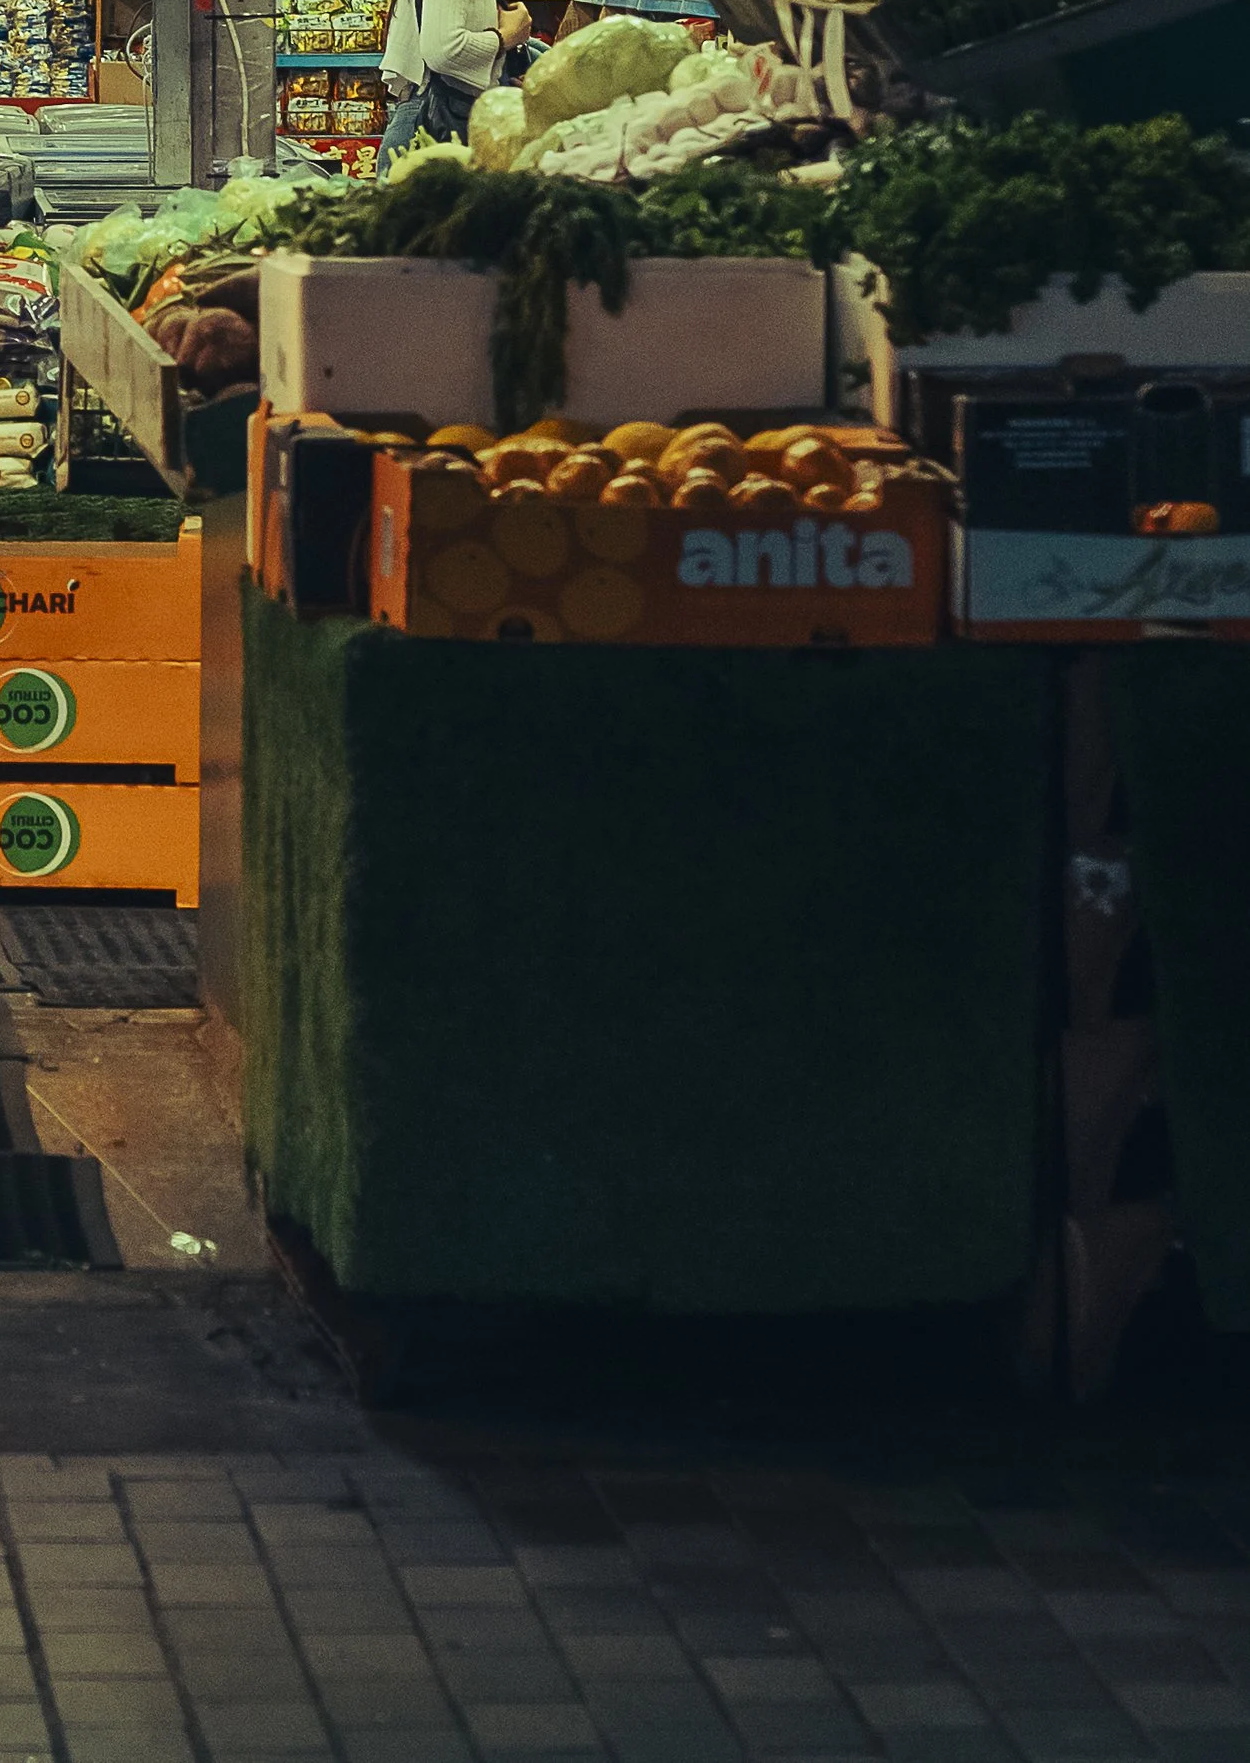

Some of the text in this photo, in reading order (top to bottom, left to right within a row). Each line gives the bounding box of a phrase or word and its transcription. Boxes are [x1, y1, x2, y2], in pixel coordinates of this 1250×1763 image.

[678, 518, 912, 588] anita
[8, 690, 52, 702] CITRUS
[10, 815, 54, 827] CITRUS
